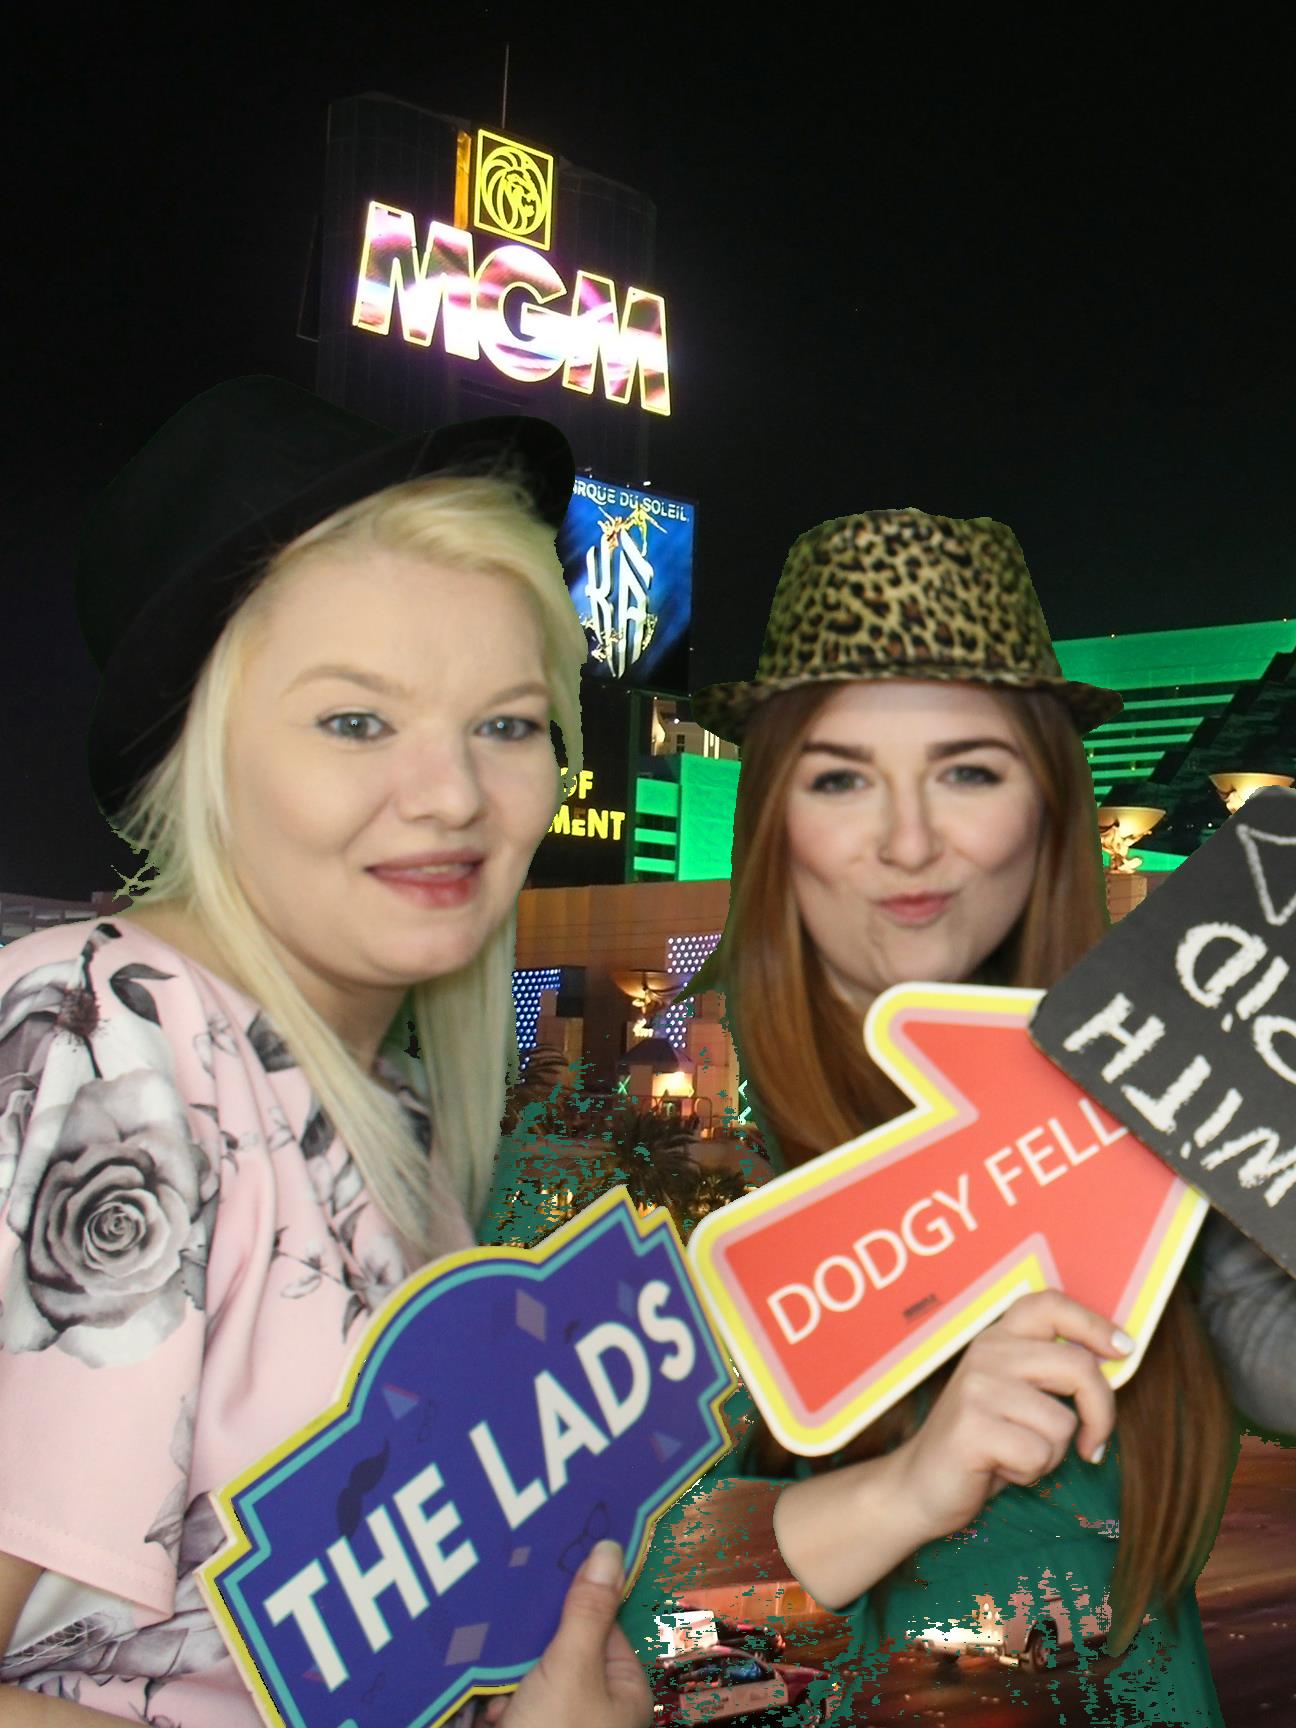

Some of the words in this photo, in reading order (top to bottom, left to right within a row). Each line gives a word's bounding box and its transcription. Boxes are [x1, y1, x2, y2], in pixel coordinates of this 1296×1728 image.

[352, 200, 671, 416] MGM
[573, 480, 616, 505] IRQUE
[620, 492, 639, 509] DU
[642, 498, 688, 522] SOLEIL
[767, 1174, 978, 1345] DODGY
[984, 1098, 1128, 1206] FELL
[263, 1464, 478, 1692] THE
[468, 1280, 696, 1530] LADS
